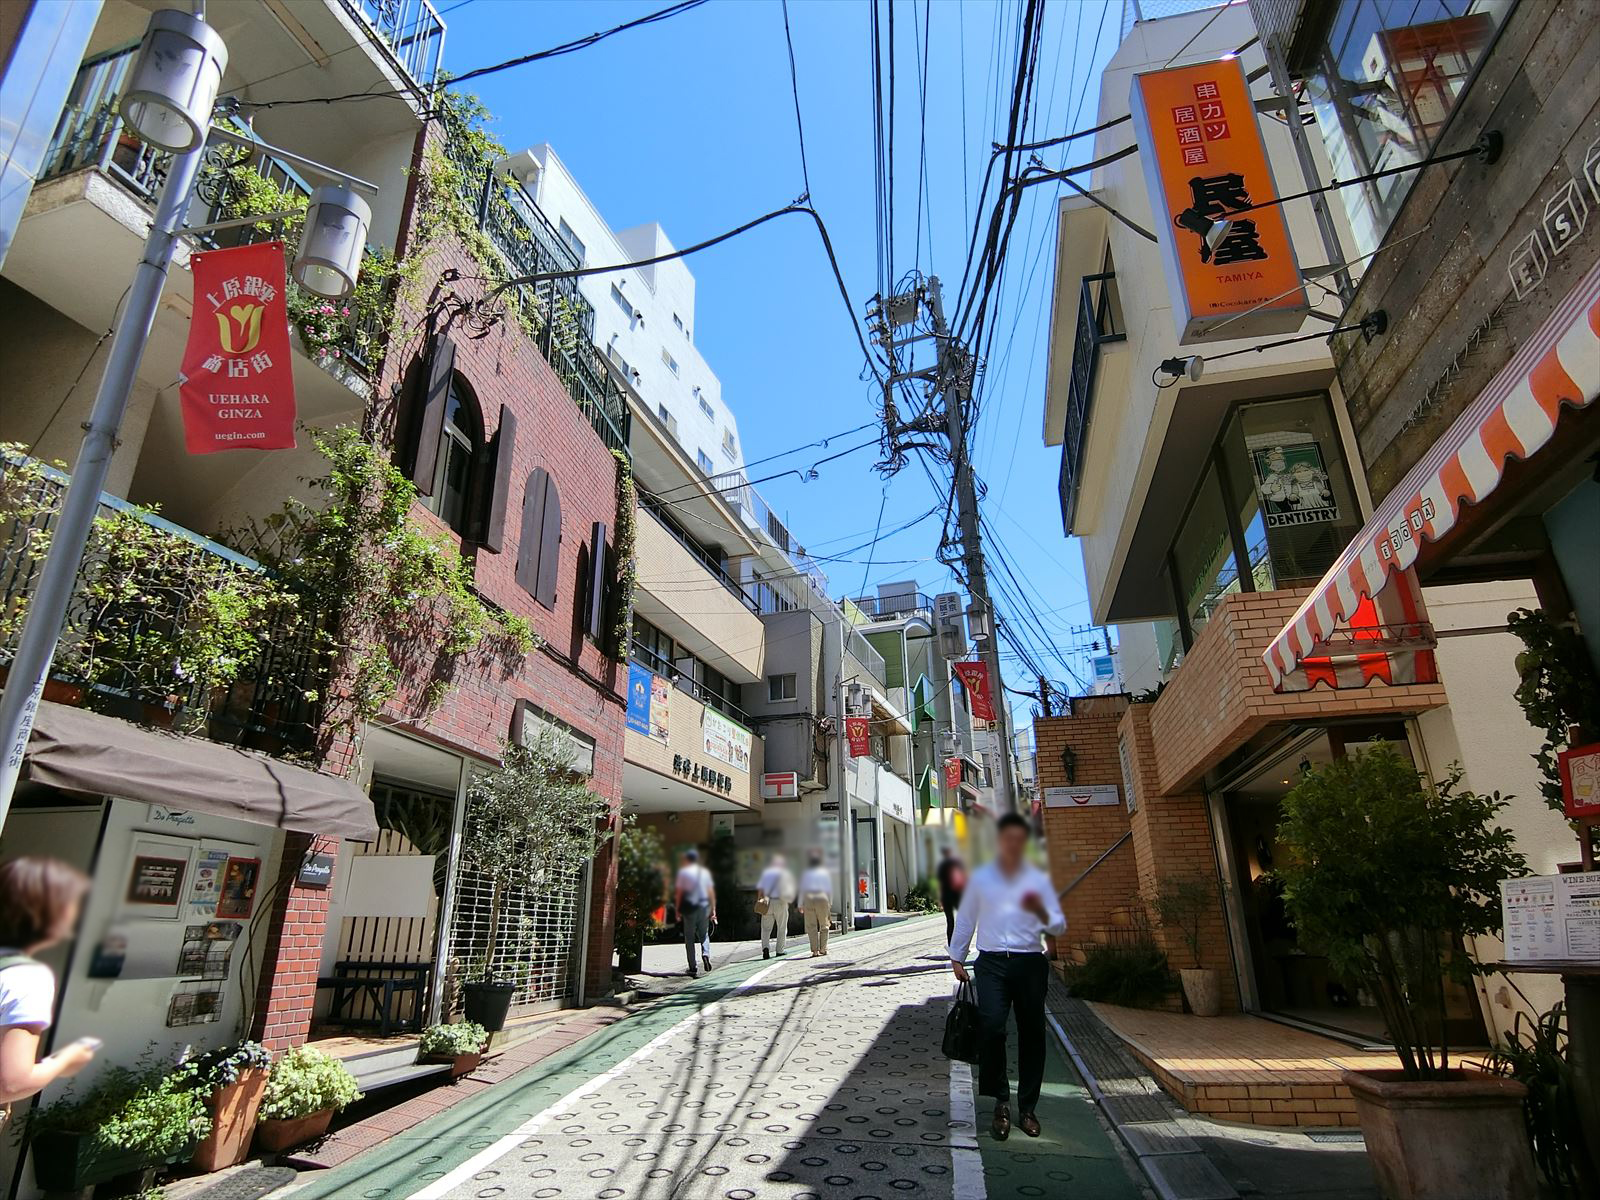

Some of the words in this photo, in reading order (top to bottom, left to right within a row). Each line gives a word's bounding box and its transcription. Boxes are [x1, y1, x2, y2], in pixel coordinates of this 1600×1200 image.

[1195, 82, 1228, 141] 串カツ
[1174, 106, 1206, 166] 居酒屋
[1215, 271, 1265, 284] TAMIYA
[206, 275, 278, 313] 上原銀座
[201, 350, 273, 378] 商店街
[208, 393, 270, 405] UEHARA
[218, 408, 263, 419] GINZA
[214, 431, 266, 441] uegin.com
[1267, 507, 1339, 527] DENTISTRY
[1382, 503, 1434, 559] ESOLA
